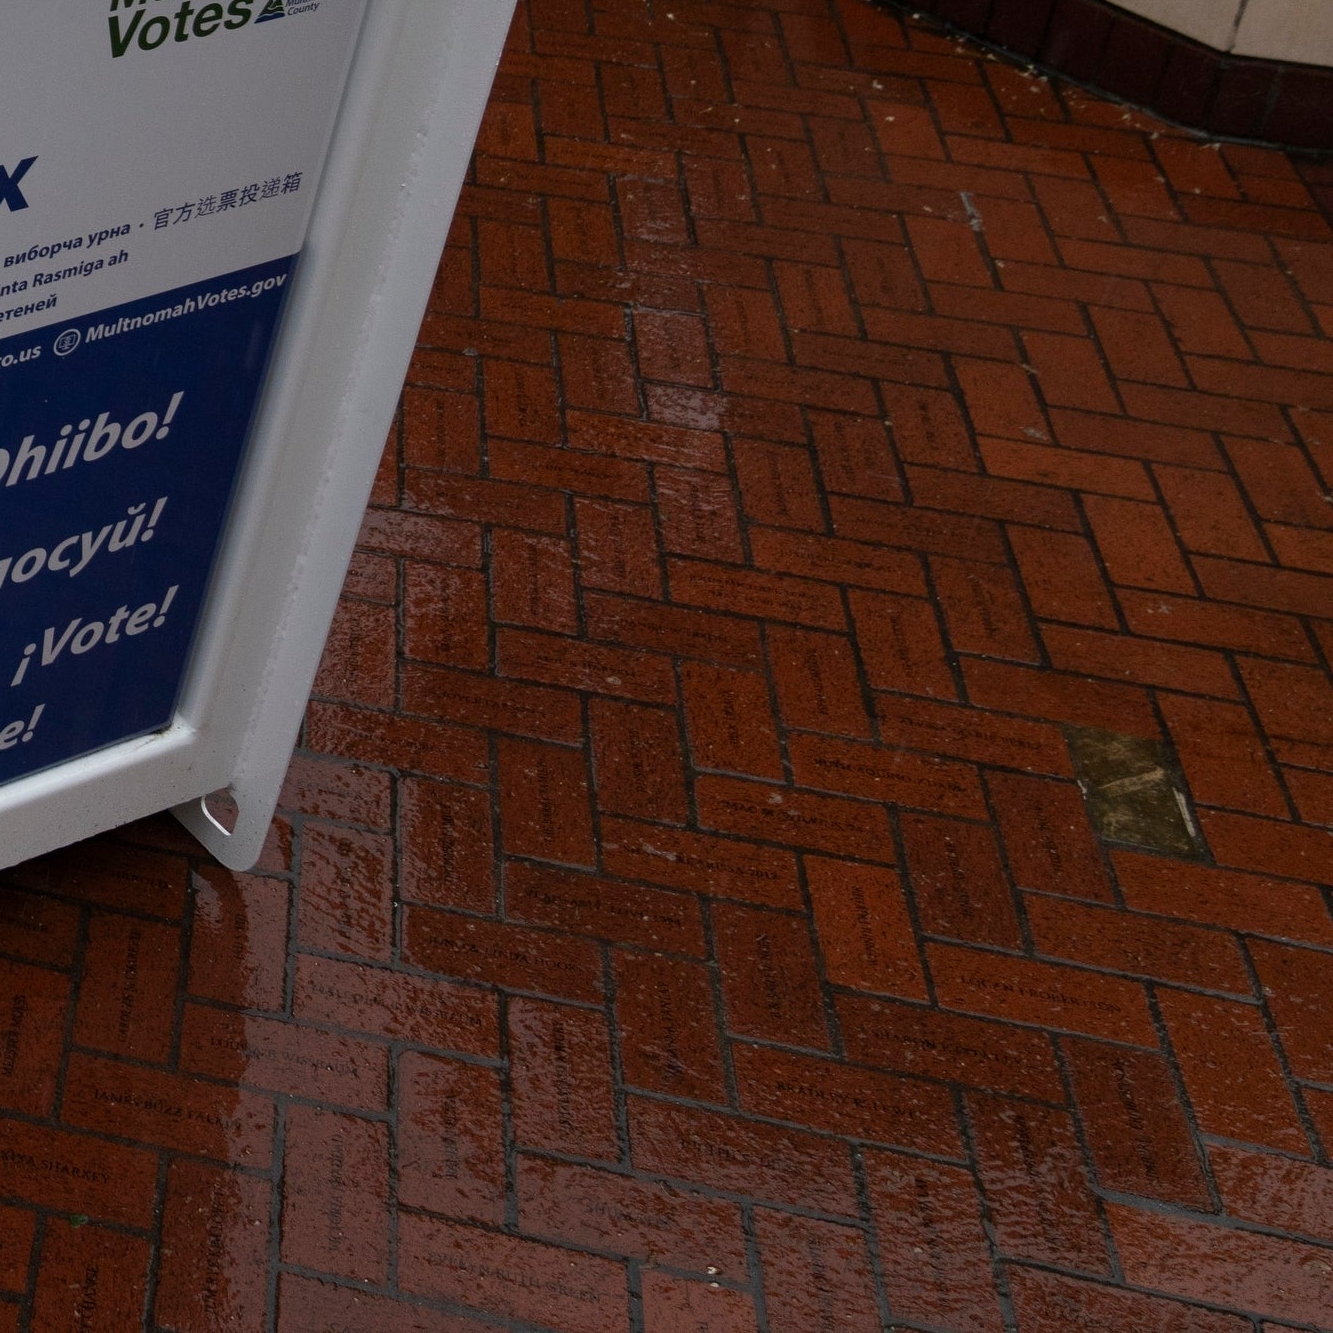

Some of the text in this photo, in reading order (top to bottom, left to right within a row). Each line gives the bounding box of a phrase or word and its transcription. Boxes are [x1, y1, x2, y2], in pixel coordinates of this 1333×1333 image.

[287, 2, 321, 17] County
[152, 170, 304, 231] 官方选票投递箱
[3, 235, 83, 267] виборча
[87, 223, 131, 250] урна
[32, 260, 104, 290] Rasmiga
[107, 250, 130, 267] ah
[84, 271, 288, 346] MultnomahVotes.gov
[8, 585, 181, 688] ¡Vote!
